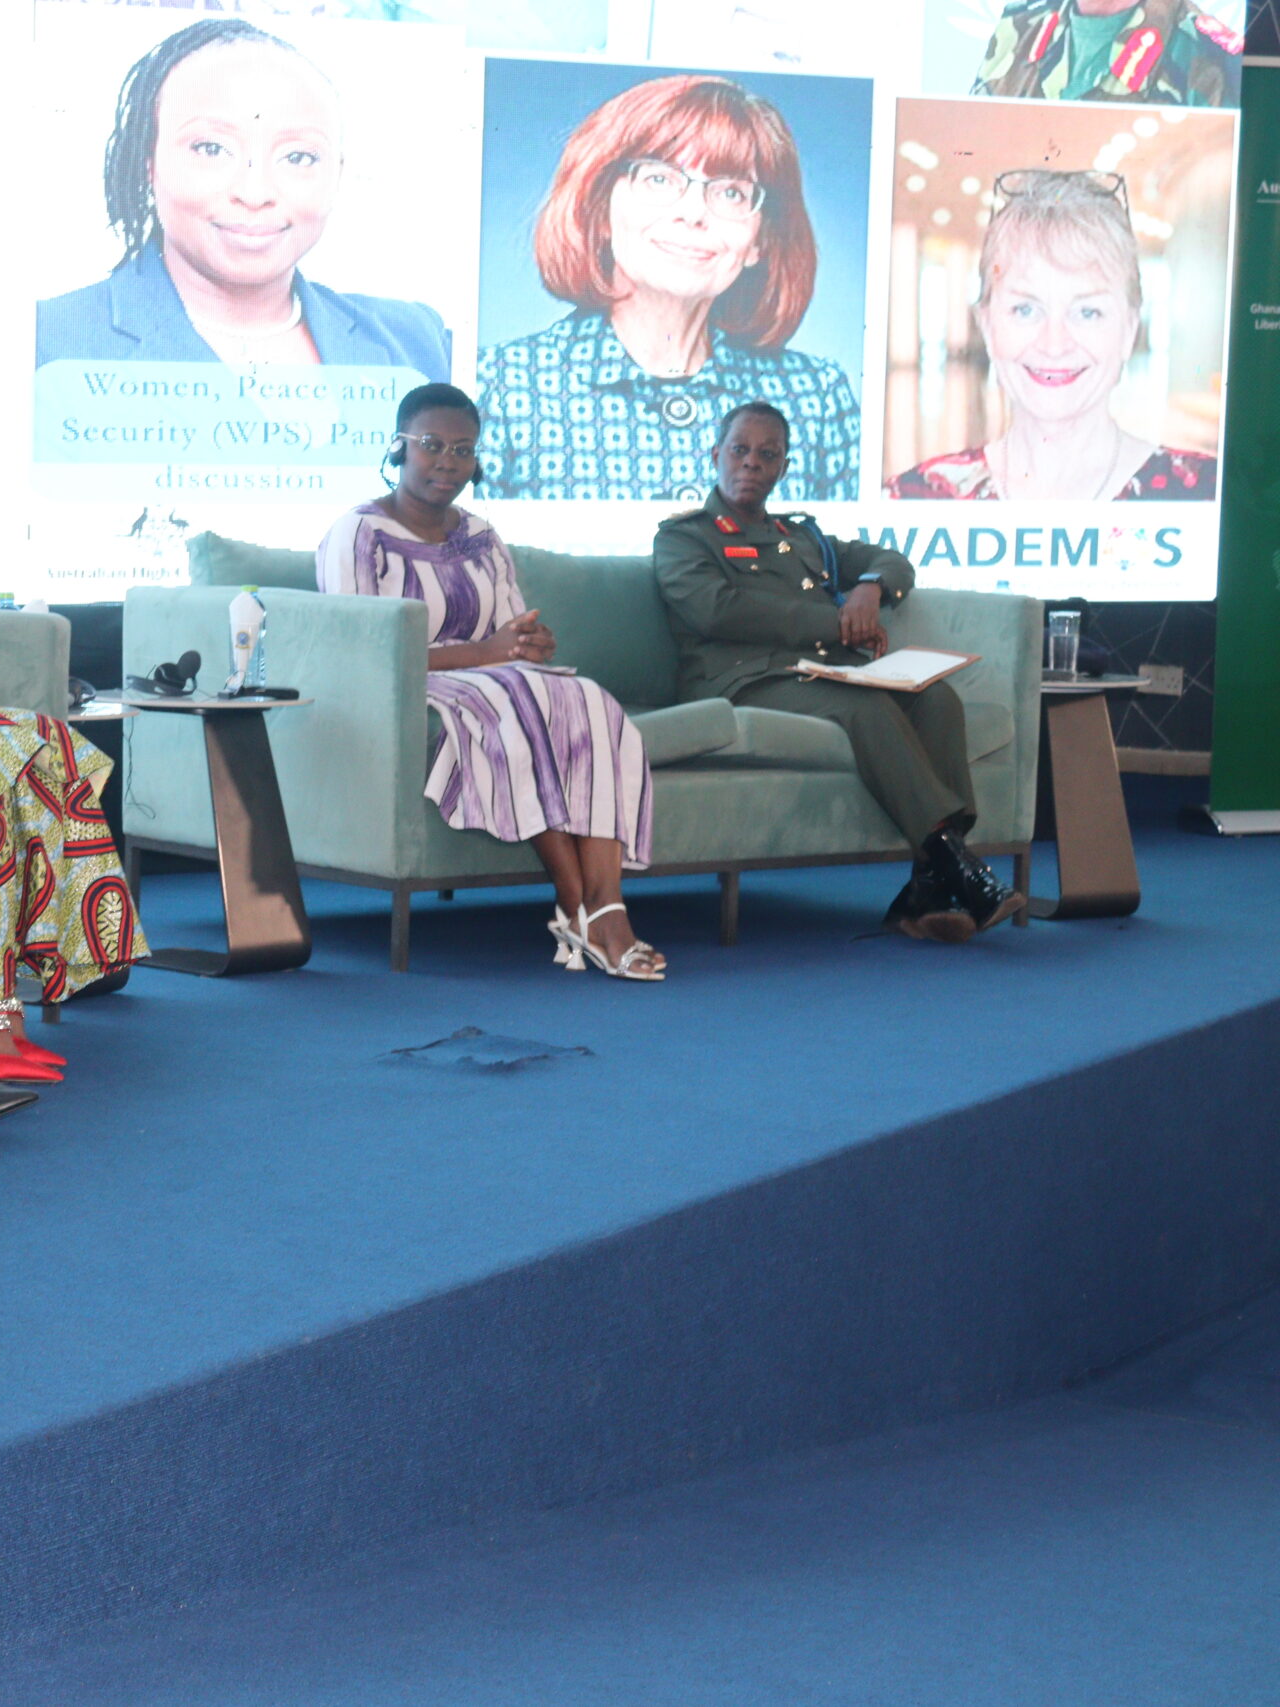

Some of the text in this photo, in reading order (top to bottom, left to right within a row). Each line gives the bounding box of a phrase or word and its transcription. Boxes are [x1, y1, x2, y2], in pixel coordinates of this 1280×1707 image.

[84, 372, 396, 402] Women, Peace and
[62, 416, 197, 450] Security
[213, 420, 312, 451] (WPS)
[155, 465, 324, 489] discussion
